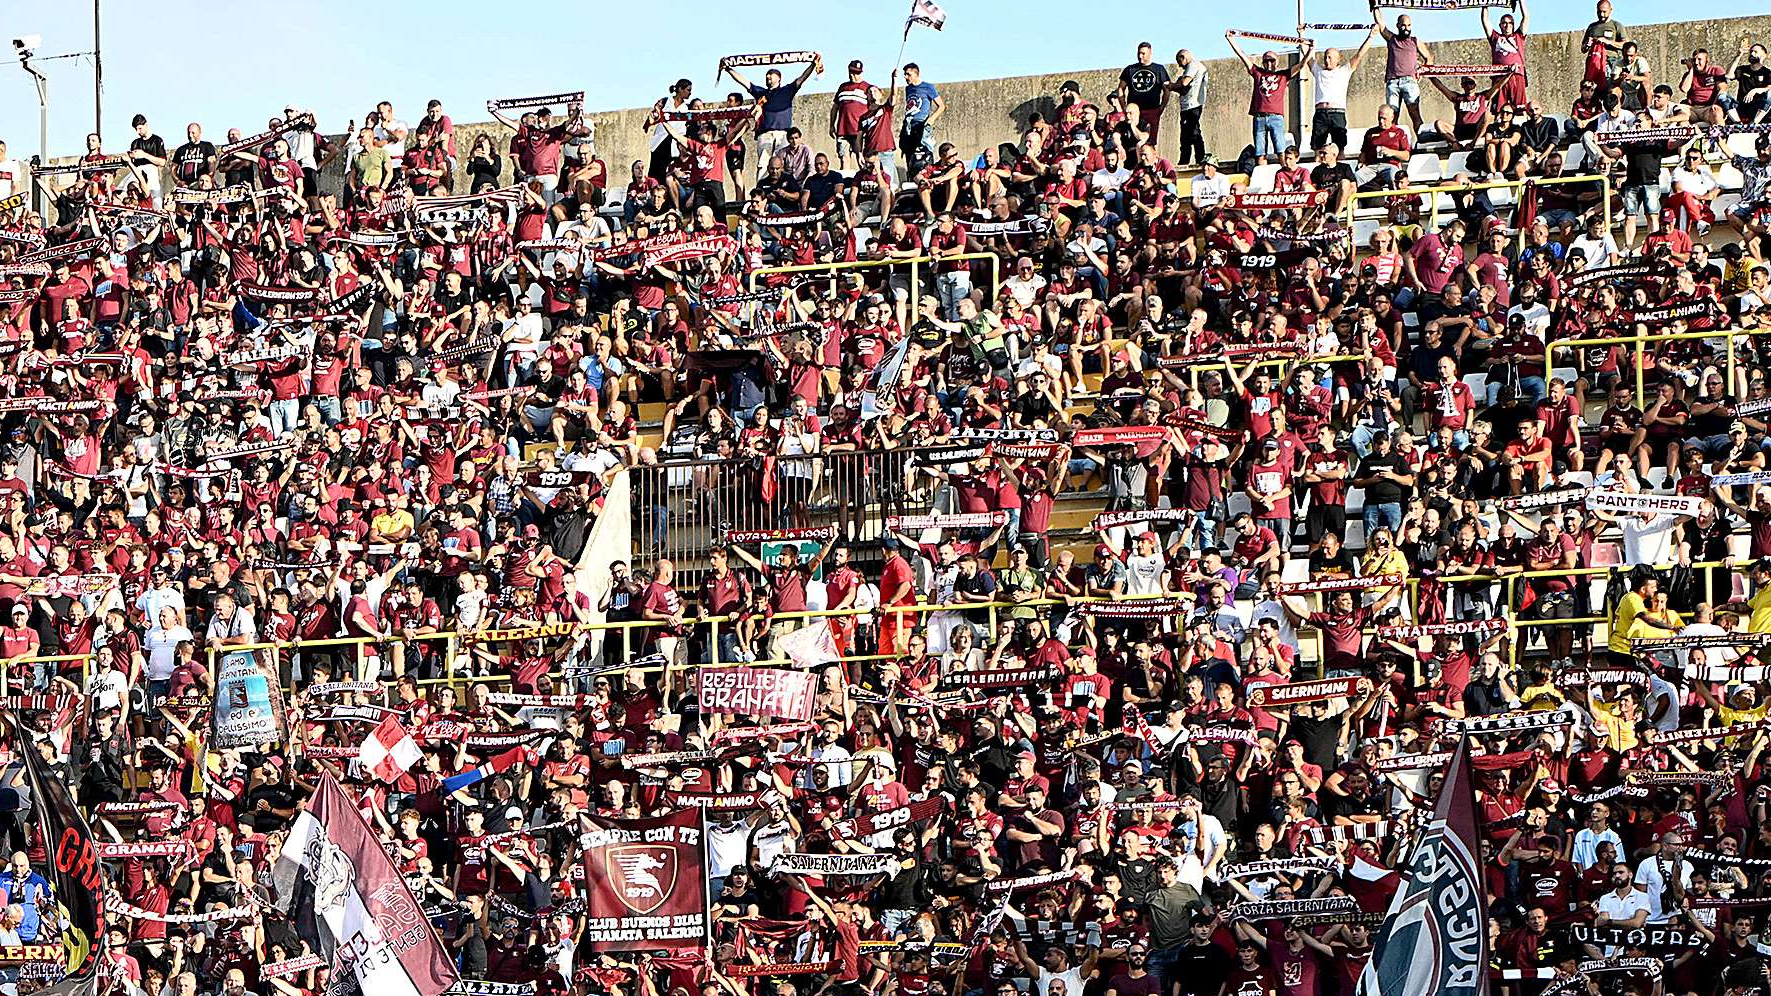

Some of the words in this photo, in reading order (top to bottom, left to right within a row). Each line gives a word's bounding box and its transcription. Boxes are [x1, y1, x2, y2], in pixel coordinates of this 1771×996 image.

[1240, 253, 1276, 267] 1919
[1633, 309, 1669, 321] MACTE
[1670, 304, 1708, 317] ANIMO
[538, 472, 572, 486] 1919
[1271, 681, 1352, 700] SALERNITANA
[677, 796, 714, 808] MACTE
[714, 795, 756, 807] ANIMO
[870, 808, 912, 828] 1919
[579, 829, 642, 845] SEMPRE
[645, 827, 674, 842] CON
[677, 827, 702, 844] TE
[105, 843, 186, 855] GRANATA
[617, 915, 670, 928] BUENOS
[671, 913, 704, 926] DIAS
[644, 926, 704, 940] SALERNO
